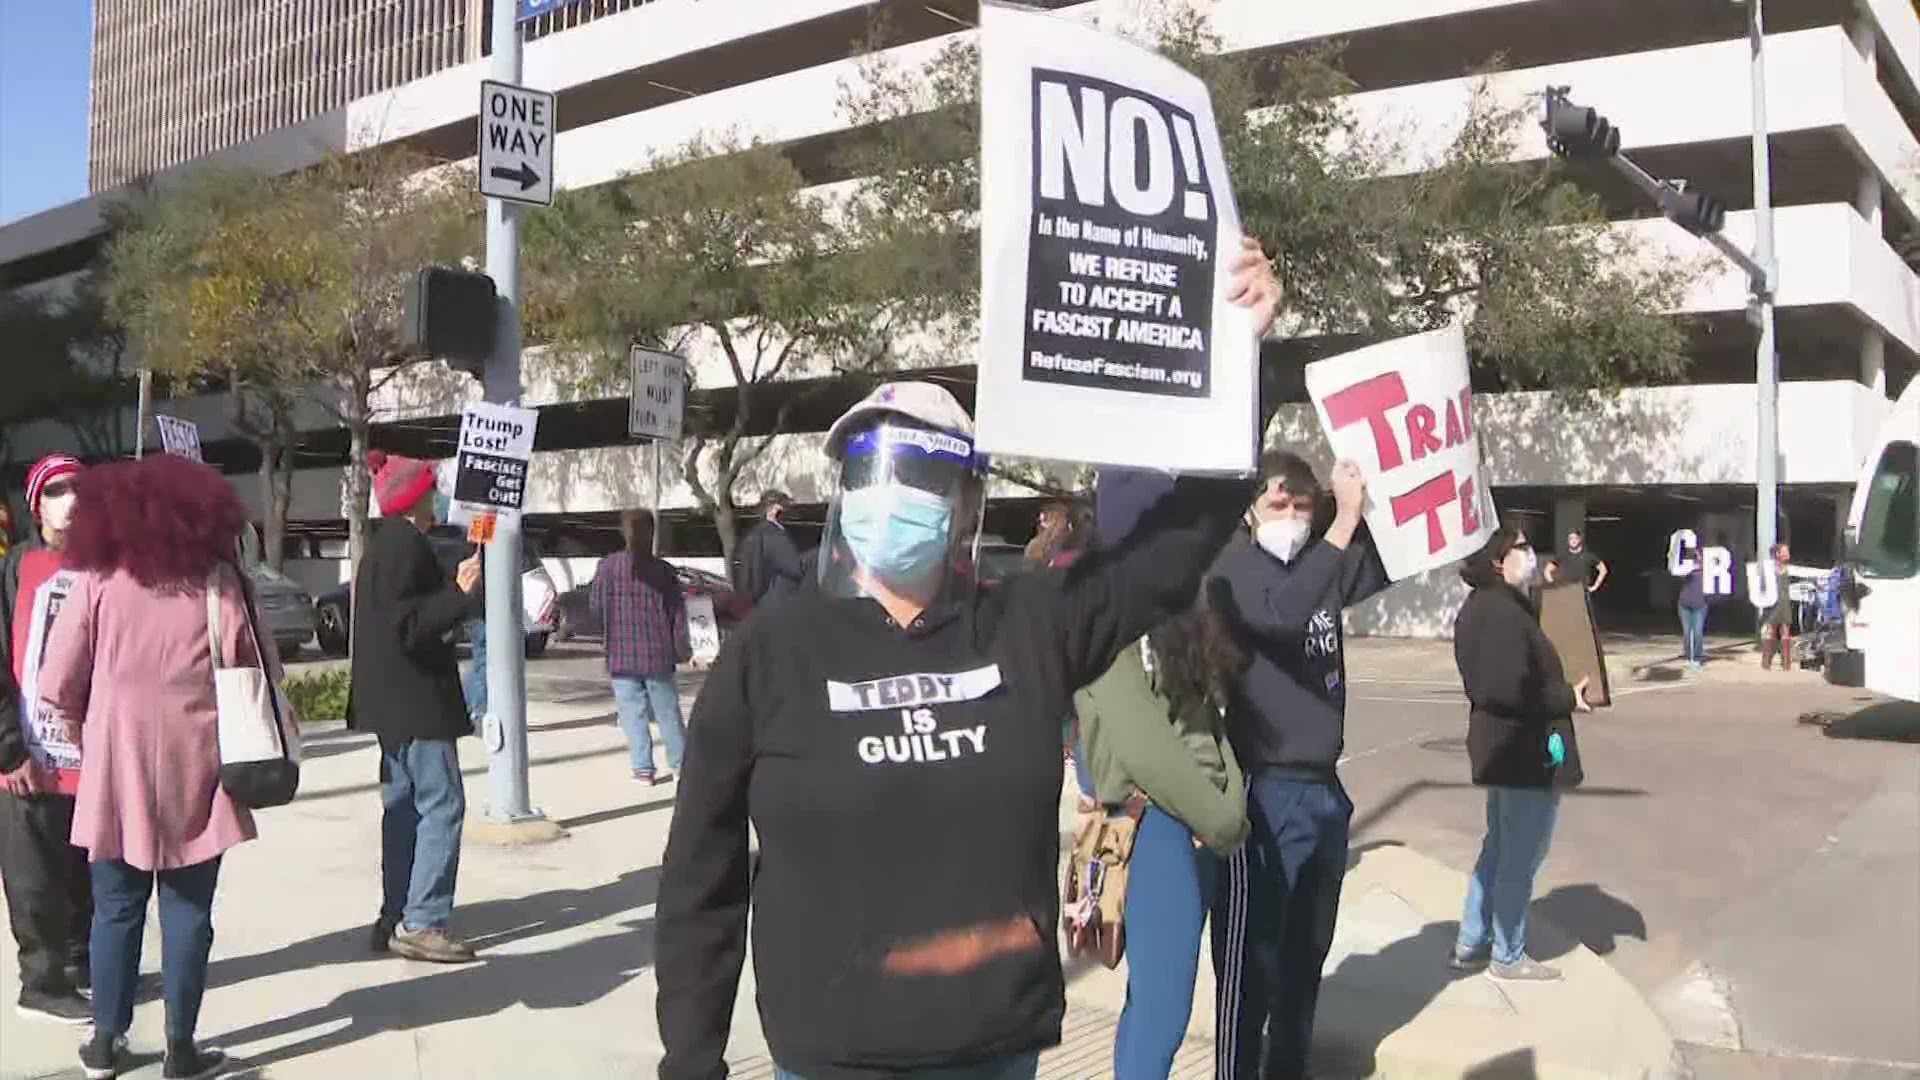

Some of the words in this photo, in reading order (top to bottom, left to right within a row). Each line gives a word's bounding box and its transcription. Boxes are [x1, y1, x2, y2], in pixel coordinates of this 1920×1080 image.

[491, 92, 545, 126] ONE
[489, 123, 546, 157] WAY
[1040, 81, 1208, 220] NO!
[1038, 213, 1053, 235] In
[1056, 216, 1080, 239] the
[1082, 219, 1121, 246] Name
[1124, 225, 1139, 248] of
[1141, 226, 1208, 261] Humanity,
[1069, 251, 1101, 277] WE
[1104, 256, 1178, 288] REFUSE
[1059, 281, 1086, 306] TO
[1088, 284, 1167, 317] ACCEPT
[1168, 294, 1183, 318] A
[1032, 308, 1114, 340] FASCIST
[1115, 319, 1204, 352] AMERICA
[1030, 350, 1203, 389] RefuseFascism.org
[463, 430, 508, 451] Lost!
[467, 412, 524, 440] Trump
[495, 475, 522, 491] Get
[852, 675, 956, 708] TEDDY
[901, 708, 937, 734] IS
[858, 725, 986, 764] GUILTY
